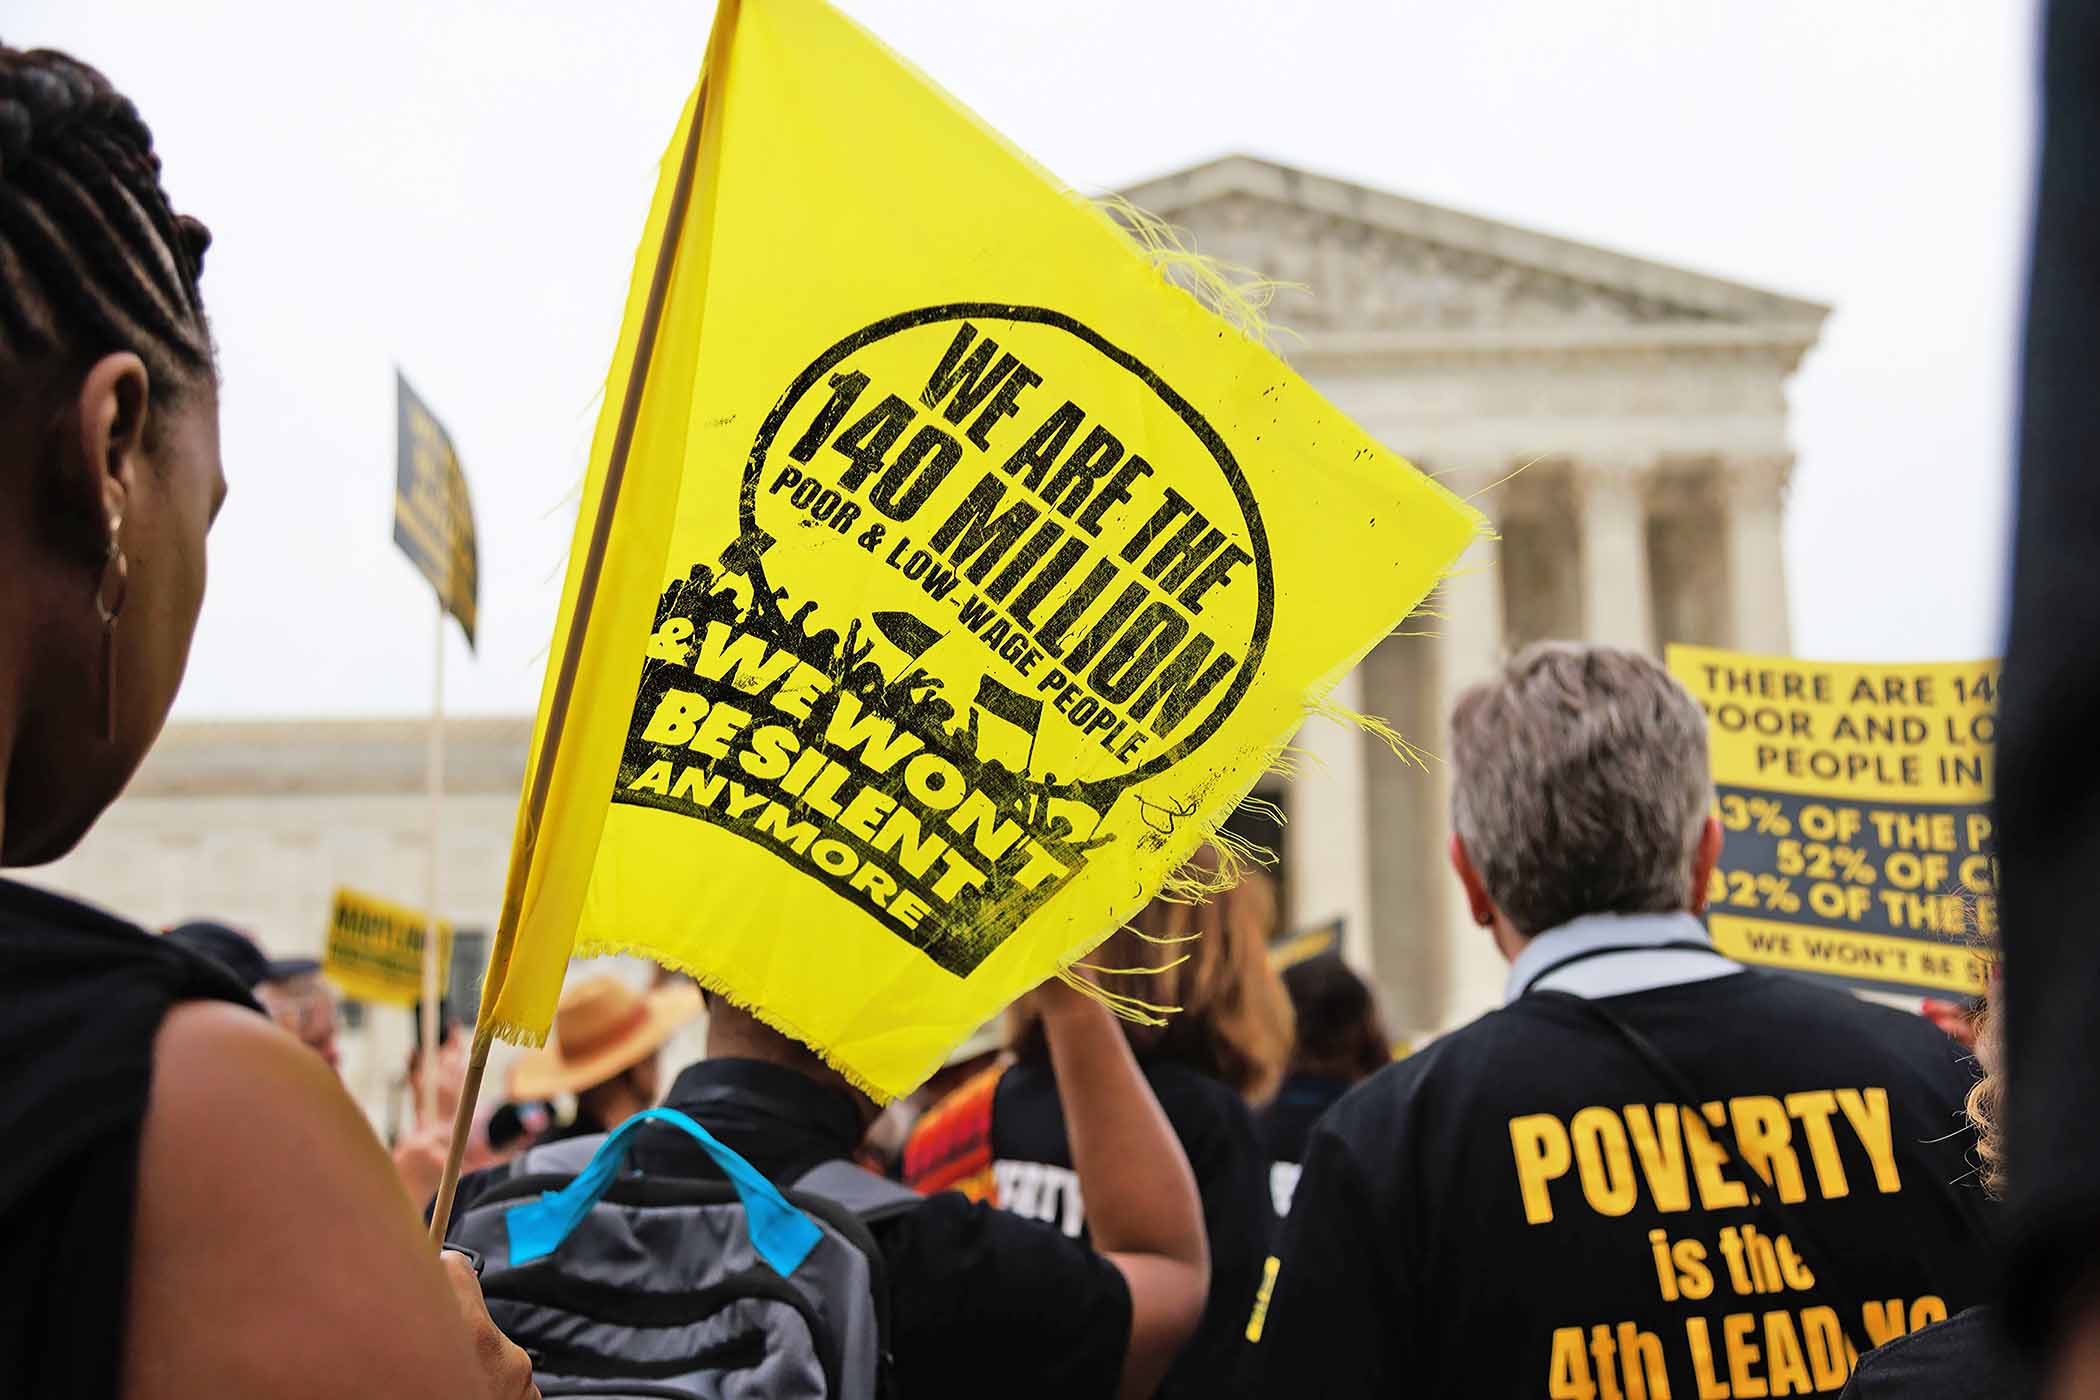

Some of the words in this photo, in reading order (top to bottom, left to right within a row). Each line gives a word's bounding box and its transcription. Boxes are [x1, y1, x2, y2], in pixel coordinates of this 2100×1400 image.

[918, 321, 1043, 453] WE
[1001, 400, 1154, 537] ARE
[1120, 487, 1254, 614] THE
[789, 370, 963, 523] 140
[927, 472, 1238, 739] MILLION
[769, 465, 864, 537] POOR
[857, 522, 889, 554] &
[1038, 670, 1150, 764] PEOPLE
[1702, 664, 1830, 700] THERE
[1851, 675, 1934, 706] ARE
[1953, 673, 2000, 704] 14
[1703, 703, 1813, 740] OOR
[1832, 714, 1928, 745] AND
[641, 688, 752, 760] BE
[738, 724, 986, 904] SILENT
[1756, 744, 1920, 786] PEOPLE
[1938, 754, 1983, 785] IN
[628, 760, 931, 930] ANYMORE
[1776, 838, 1877, 885] 52%
[1884, 852, 1949, 891] OF
[1798, 804, 1861, 843] OF
[1868, 811, 1956, 852] THE
[1746, 928, 1793, 954] WE
[1806, 881, 1872, 921] OF
[1878, 889, 1966, 936] THE
[1508, 1087, 1902, 1225] POVERTY
[1648, 1228, 1707, 1302] is
[1719, 1223, 1816, 1296] the
[1549, 1320, 1672, 1400] 4th
